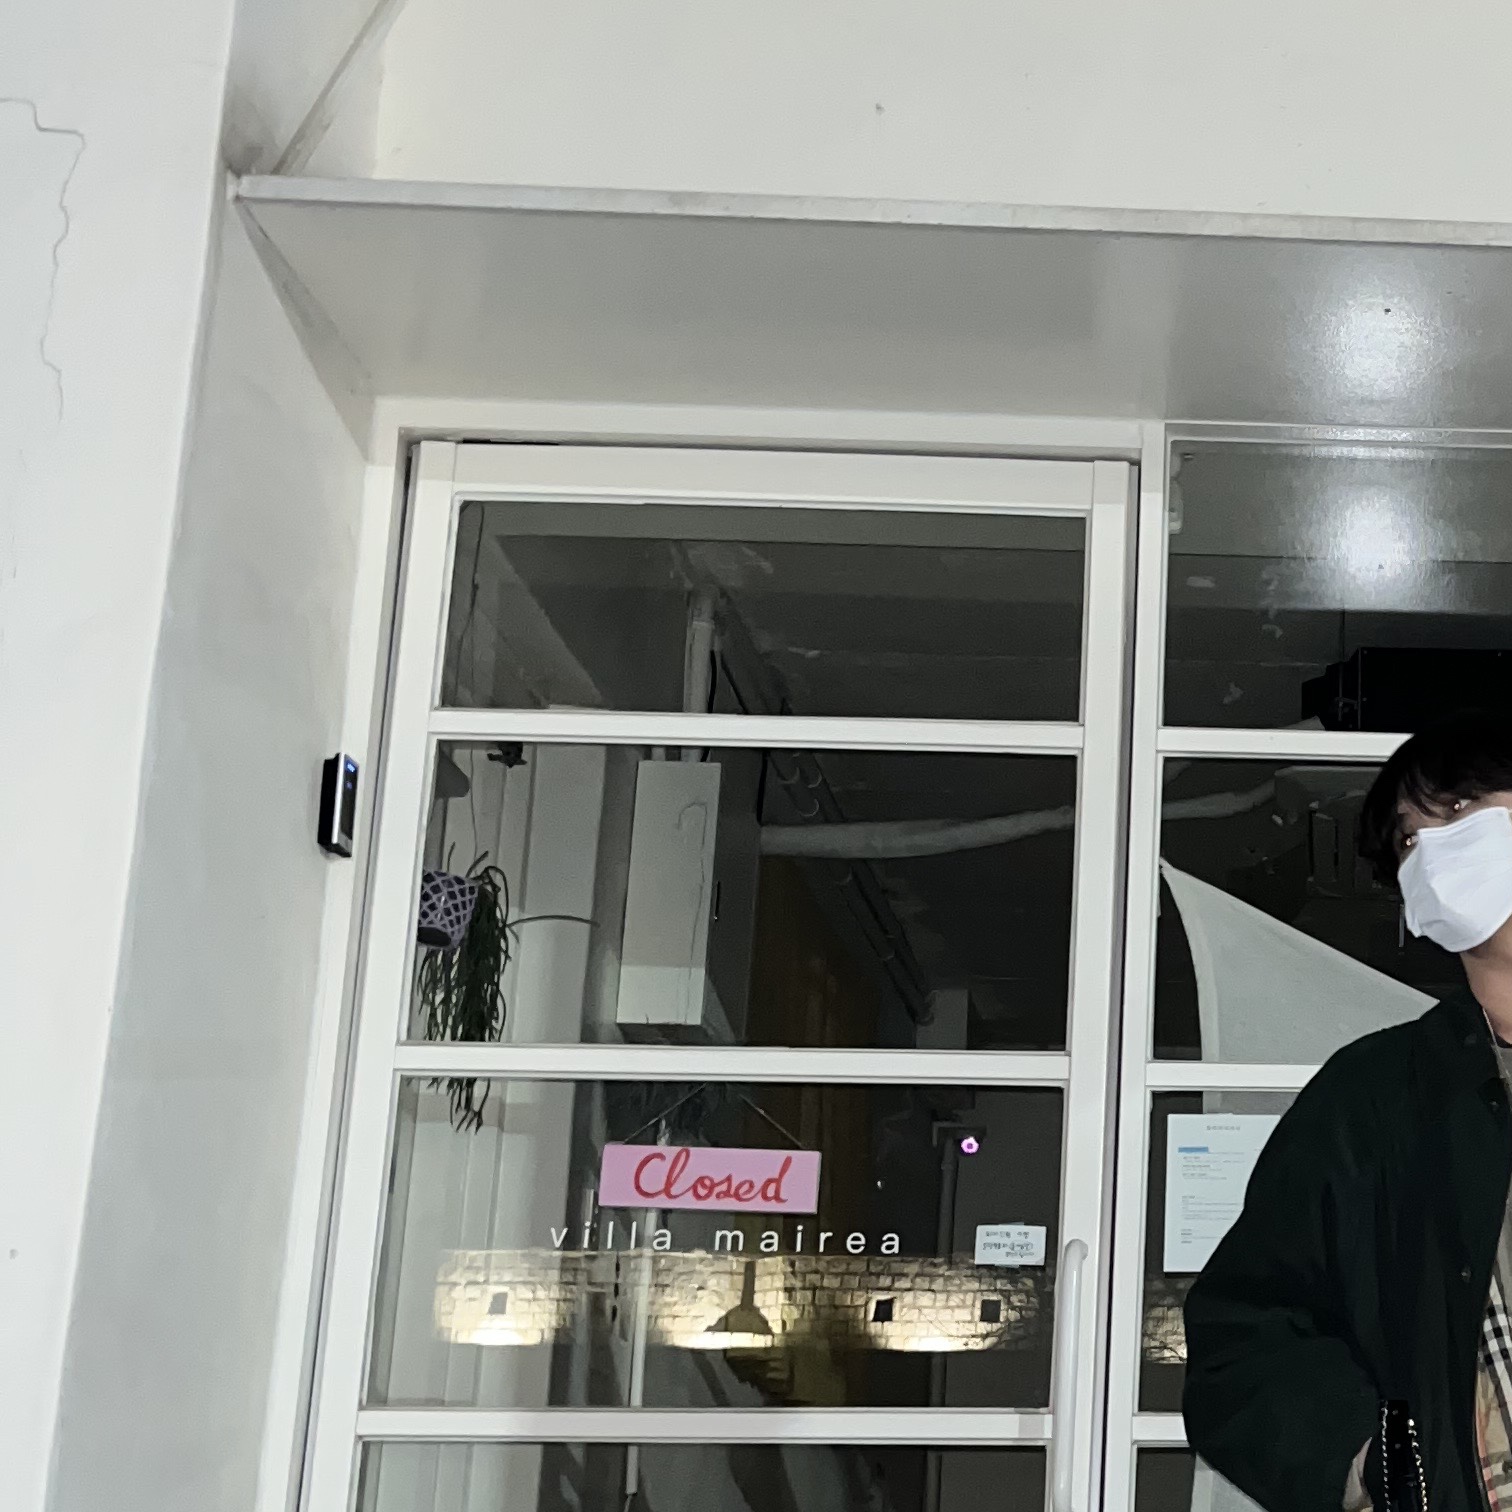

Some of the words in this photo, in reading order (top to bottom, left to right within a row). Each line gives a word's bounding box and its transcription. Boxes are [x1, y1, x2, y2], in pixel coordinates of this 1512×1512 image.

[633, 1147, 793, 1204] Closed
[550, 1220, 672, 1251] villa
[714, 1224, 901, 1255] mairea
